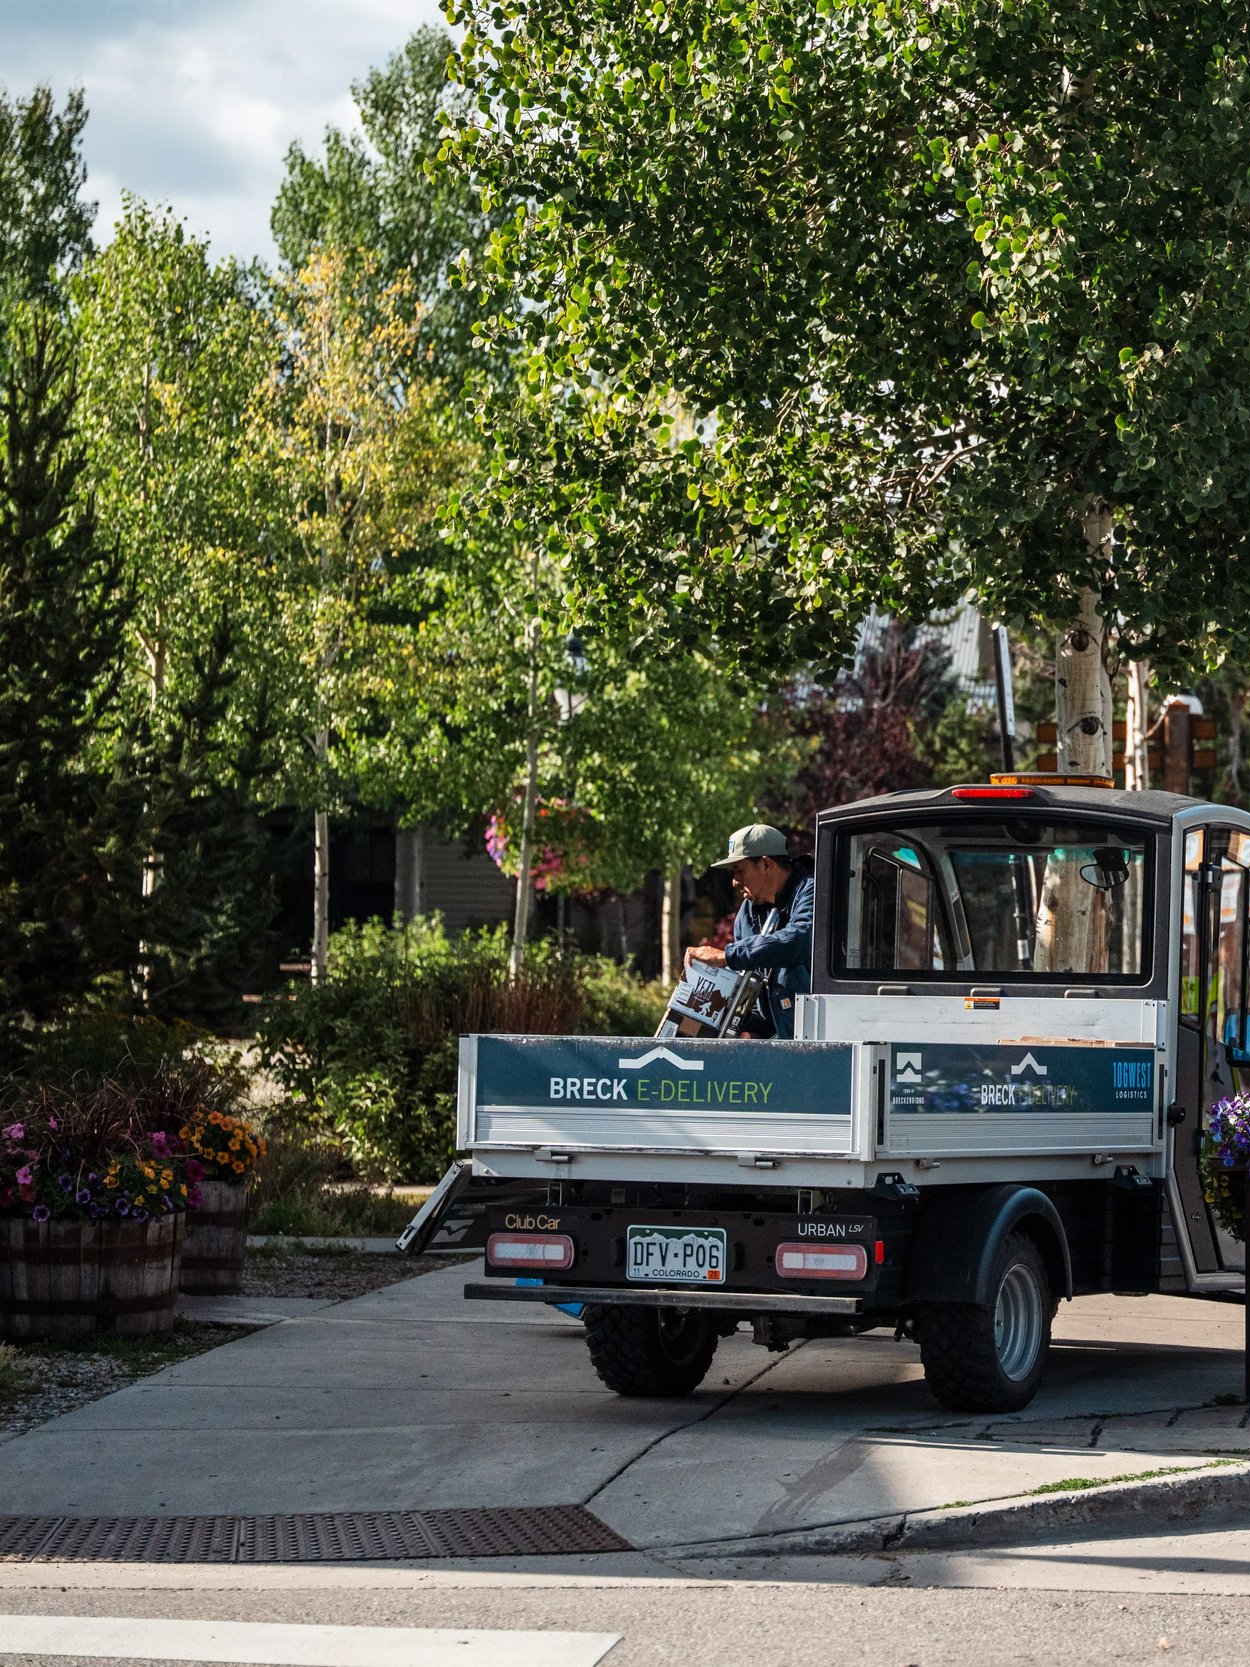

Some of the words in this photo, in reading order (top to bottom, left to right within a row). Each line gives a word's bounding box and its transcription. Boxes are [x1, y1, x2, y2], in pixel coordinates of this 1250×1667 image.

[1113, 1061, 1151, 1088] 106WEST
[550, 1077, 628, 1100] BRECK
[637, 1079, 773, 1103] E-DELIVERY
[981, 1084, 1016, 1105] BRECK
[1018, 1084, 1075, 1106] EDELIVERY
[1115, 1090, 1147, 1099] LOGISTICS
[505, 1213, 535, 1229] Club
[536, 1215, 560, 1230] Car
[798, 1223, 846, 1237] URBAN
[848, 1224, 864, 1233] LSV
[652, 1269, 700, 1278] COLORADO
